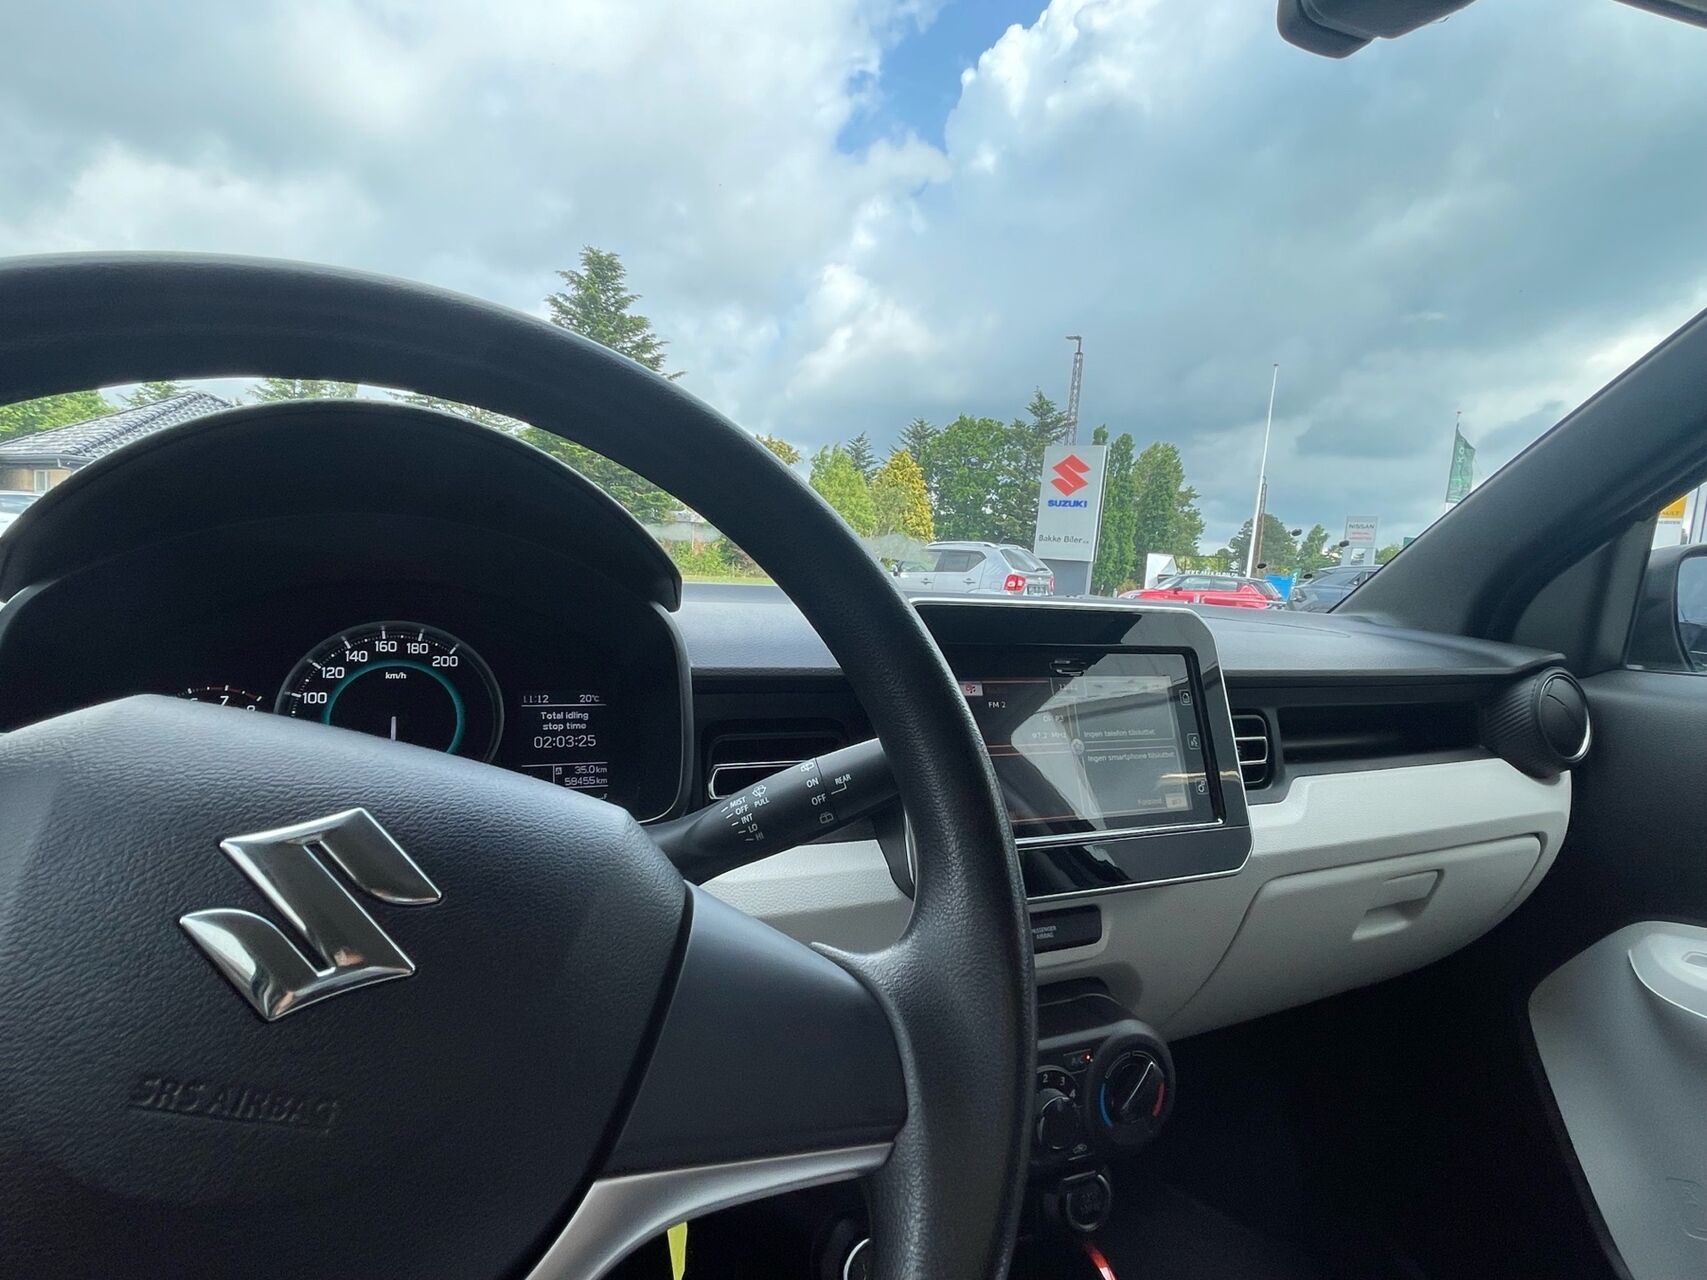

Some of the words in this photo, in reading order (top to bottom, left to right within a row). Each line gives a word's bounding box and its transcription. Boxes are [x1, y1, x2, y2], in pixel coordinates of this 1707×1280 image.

[1048, 500, 1087, 508] SUZUKI
[1039, 535, 1062, 543] Bakke
[375, 641, 397, 652] 160
[406, 643, 429, 654] 180
[345, 651, 368, 662] 140
[432, 656, 458, 667] 200
[322, 667, 345, 679] 120
[220, 695, 229, 706] 7
[302, 692, 327, 704] 100
[523, 695, 549, 703] 11:12
[988, 701, 1000, 709] FM
[1001, 701, 1006, 709] 2
[541, 711, 564, 720] Total
[565, 711, 589, 721] idling
[542, 722, 564, 731] stop
[566, 722, 587, 730] time
[533, 734, 597, 749] 02:03:25
[574, 765, 596, 774] 35.0
[806, 777, 820, 788] ON
[834, 774, 852, 785] REAR
[730, 796, 747, 808] MIST
[754, 798, 770, 808] PULL
[811, 793, 827, 806] OFF
[735, 806, 749, 816] OFF
[741, 813, 754, 825] INT
[748, 823, 758, 833] LO
[755, 832, 765, 841] HI
[1043, 1073, 1049, 1083] 2
[1060, 1076, 1066, 1086] 3
[1069, 1089, 1076, 1099] 4
